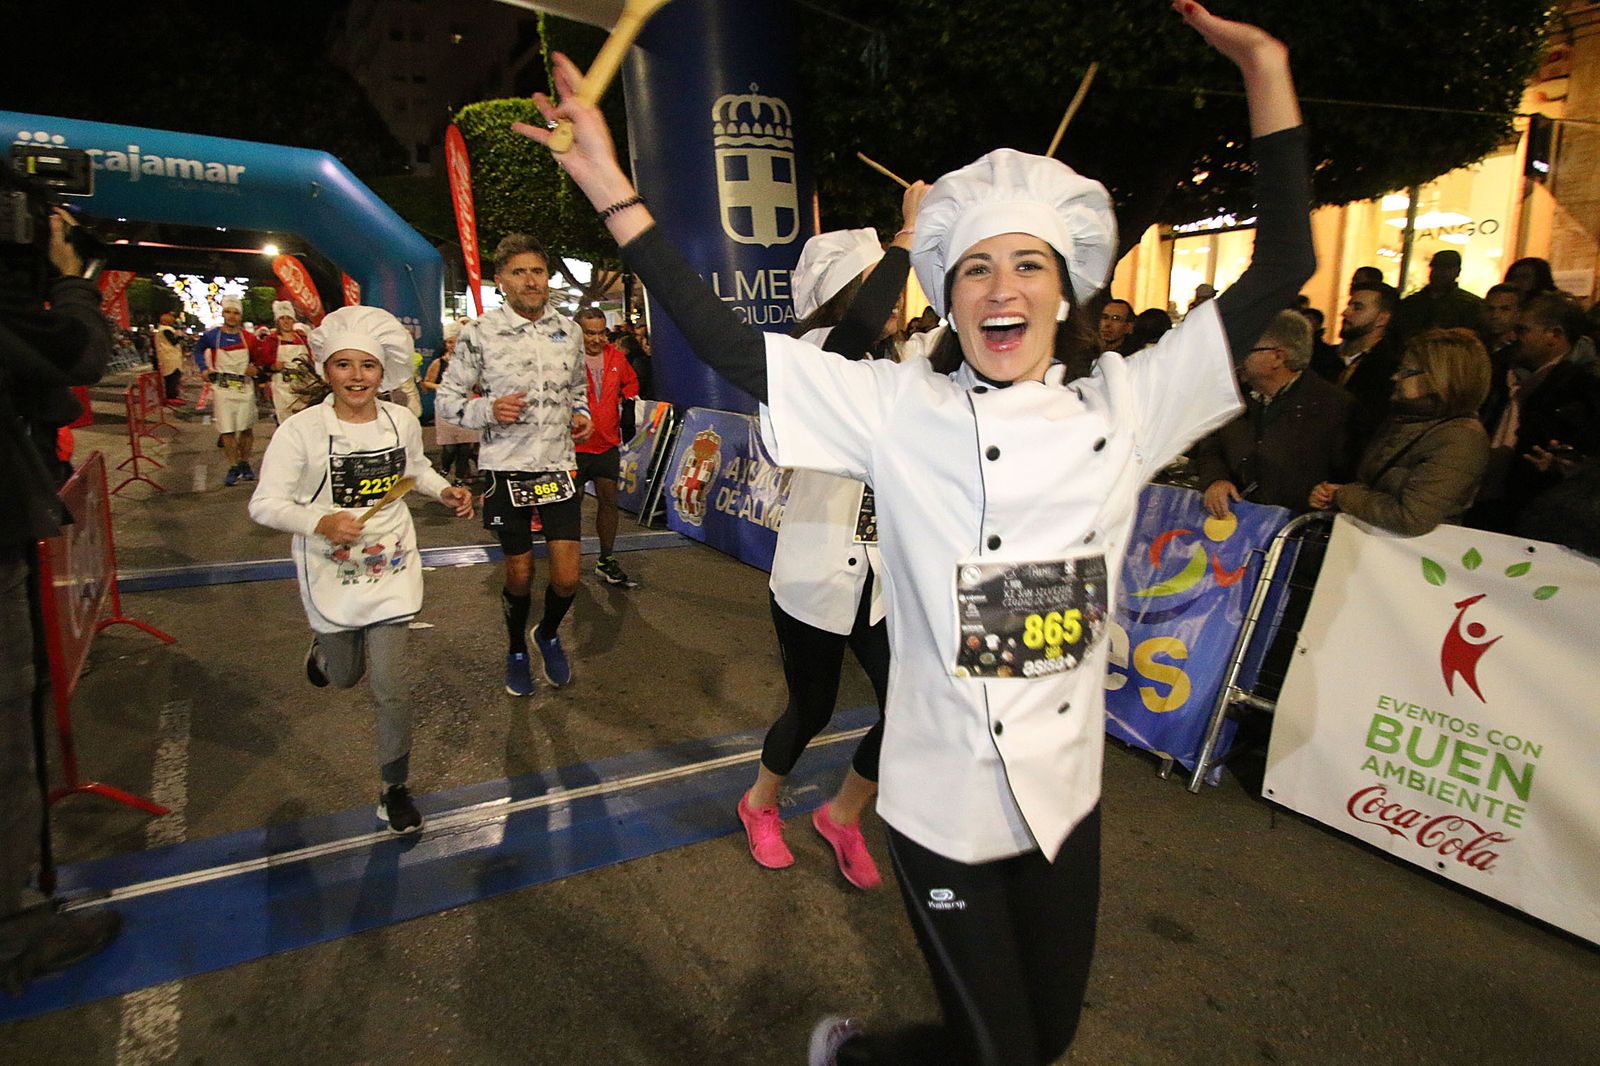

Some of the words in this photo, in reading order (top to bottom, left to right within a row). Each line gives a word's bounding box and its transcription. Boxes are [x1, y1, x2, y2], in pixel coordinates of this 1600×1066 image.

[85, 145, 246, 184] cajamar
[534, 482, 559, 495] 868
[714, 486, 741, 516] DE
[1023, 608, 1082, 649] 865
[1376, 695, 1480, 738] EVENTOS
[1487, 730, 1543, 759] CON
[1365, 713, 1536, 802] BUEN
[1360, 755, 1526, 829] AMBIENTE
